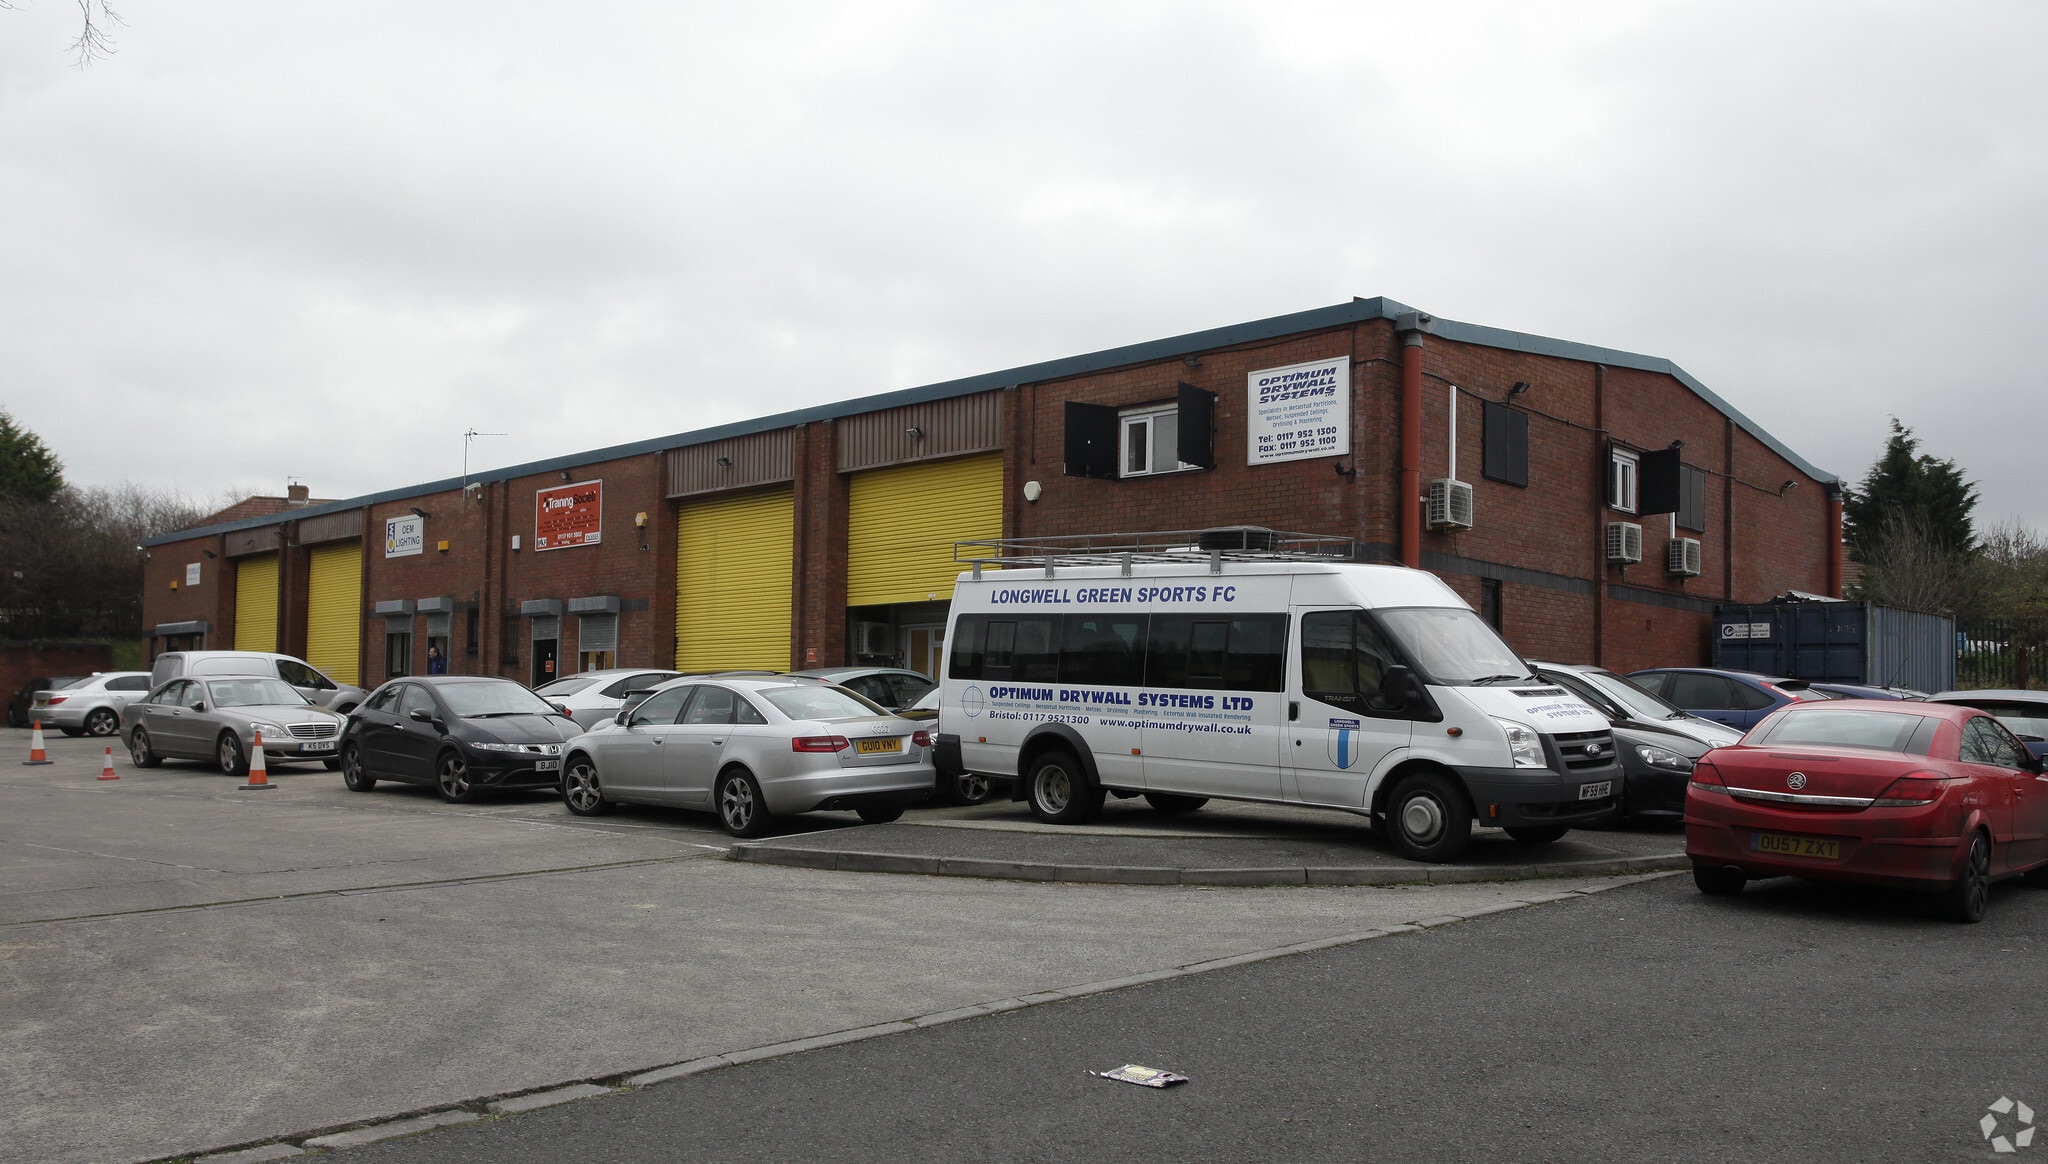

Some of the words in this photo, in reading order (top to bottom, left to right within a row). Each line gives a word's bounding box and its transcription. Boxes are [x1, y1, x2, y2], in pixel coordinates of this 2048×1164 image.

[1258, 367, 1337, 387] OPTIMUM
[1259, 377, 1336, 395] DRYWALL
[1258, 385, 1336, 404] SYSTEMS
[1258, 407, 1282, 416] Specialists
[1289, 402, 1312, 411] Metalstud
[1284, 410, 1309, 419] Suspended
[1272, 420, 1293, 428] Drylining
[1298, 416, 1323, 424] Plastering
[1258, 434, 1274, 444] Tel:
[1276, 432, 1294, 442] 0117
[1297, 429, 1313, 439] 952
[1316, 426, 1337, 436] 1300
[1258, 444, 1277, 453] Fax:
[1280, 441, 1297, 451] 0117
[1300, 438, 1315, 448] 952
[1318, 436, 1337, 445] 1100
[1259, 446, 1336, 458] www.optimumdrywall.co.uk
[402, 524, 414, 534] OEM
[395, 536, 420, 548] LIGHTING
[990, 588, 1071, 604] LONGWELL
[1076, 587, 1133, 603] GREEN
[1137, 586, 1207, 603] SPORTS
[1212, 586, 1236, 602] FC
[989, 686, 1053, 701] OPTIMUM
[1059, 689, 1131, 705] DRYWALL
[1138, 692, 1215, 709] SYSTEMS
[1222, 696, 1254, 711] LTD
[991, 700, 1014, 708] Suspended
[1106, 707, 1129, 715] Drylining
[1133, 708, 1158, 716] Plastering
[1197, 712, 1223, 720] Insulated
[1223, 713, 1252, 721] Rendering
[1526, 703, 1562, 715] OPTIMUM
[1546, 709, 1580, 719] SYSTEMS
[989, 710, 1021, 720] Bristol:
[1022, 712, 1046, 722] 0117
[1047, 714, 1090, 725] 9521300
[1099, 718, 1252, 735] www.optimumdrywall.co.uk
[881, 740, 897, 750] VNY
[540, 761, 557, 770] BJ10
[1582, 784, 1599, 798] WF59
[1598, 782, 1610, 796] HHE
[1761, 835, 1800, 853] OU57
[1805, 839, 1837, 856] ZXT
